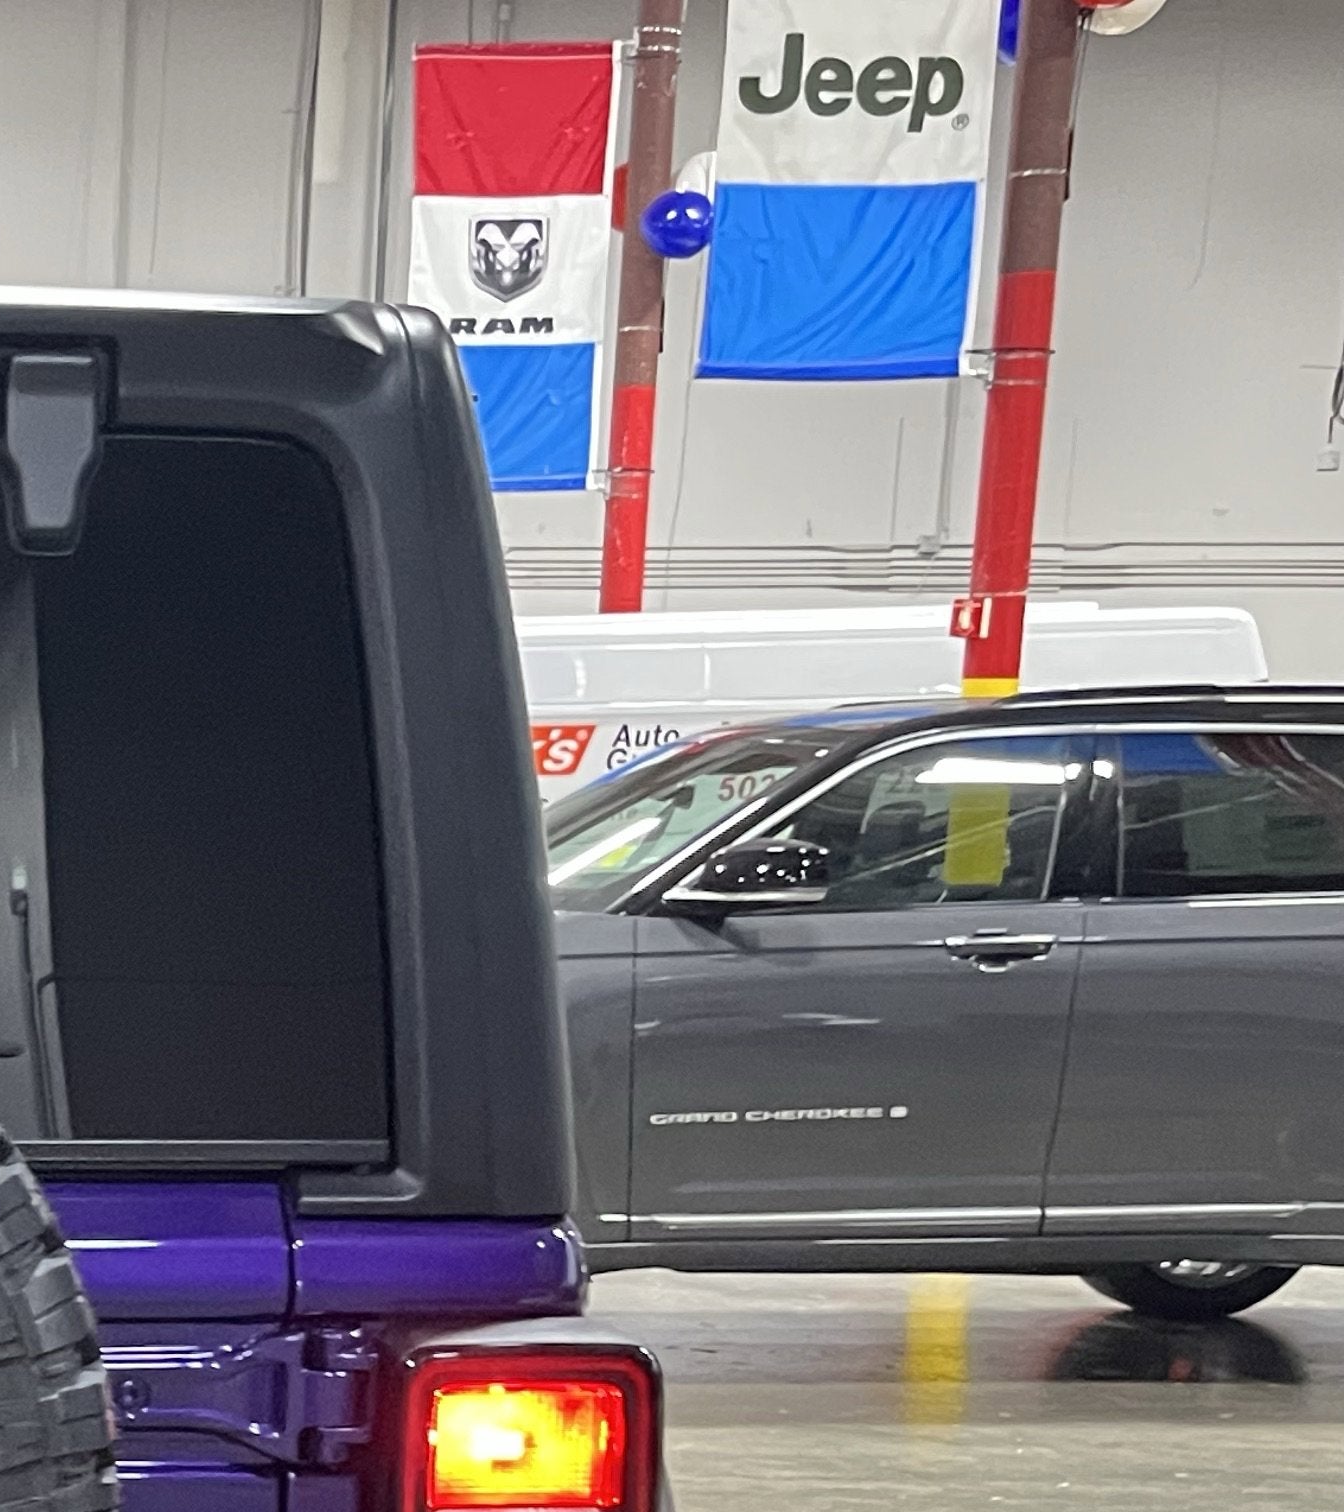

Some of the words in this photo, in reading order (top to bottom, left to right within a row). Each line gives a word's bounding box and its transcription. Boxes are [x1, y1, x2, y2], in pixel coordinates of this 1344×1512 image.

[739, 33, 964, 133] Jeep
[449, 317, 554, 335] RAM
[612, 724, 679, 748] Auto
[650, 1112, 738, 1124] GRAND
[745, 1107, 884, 1121] CHEROKEE
